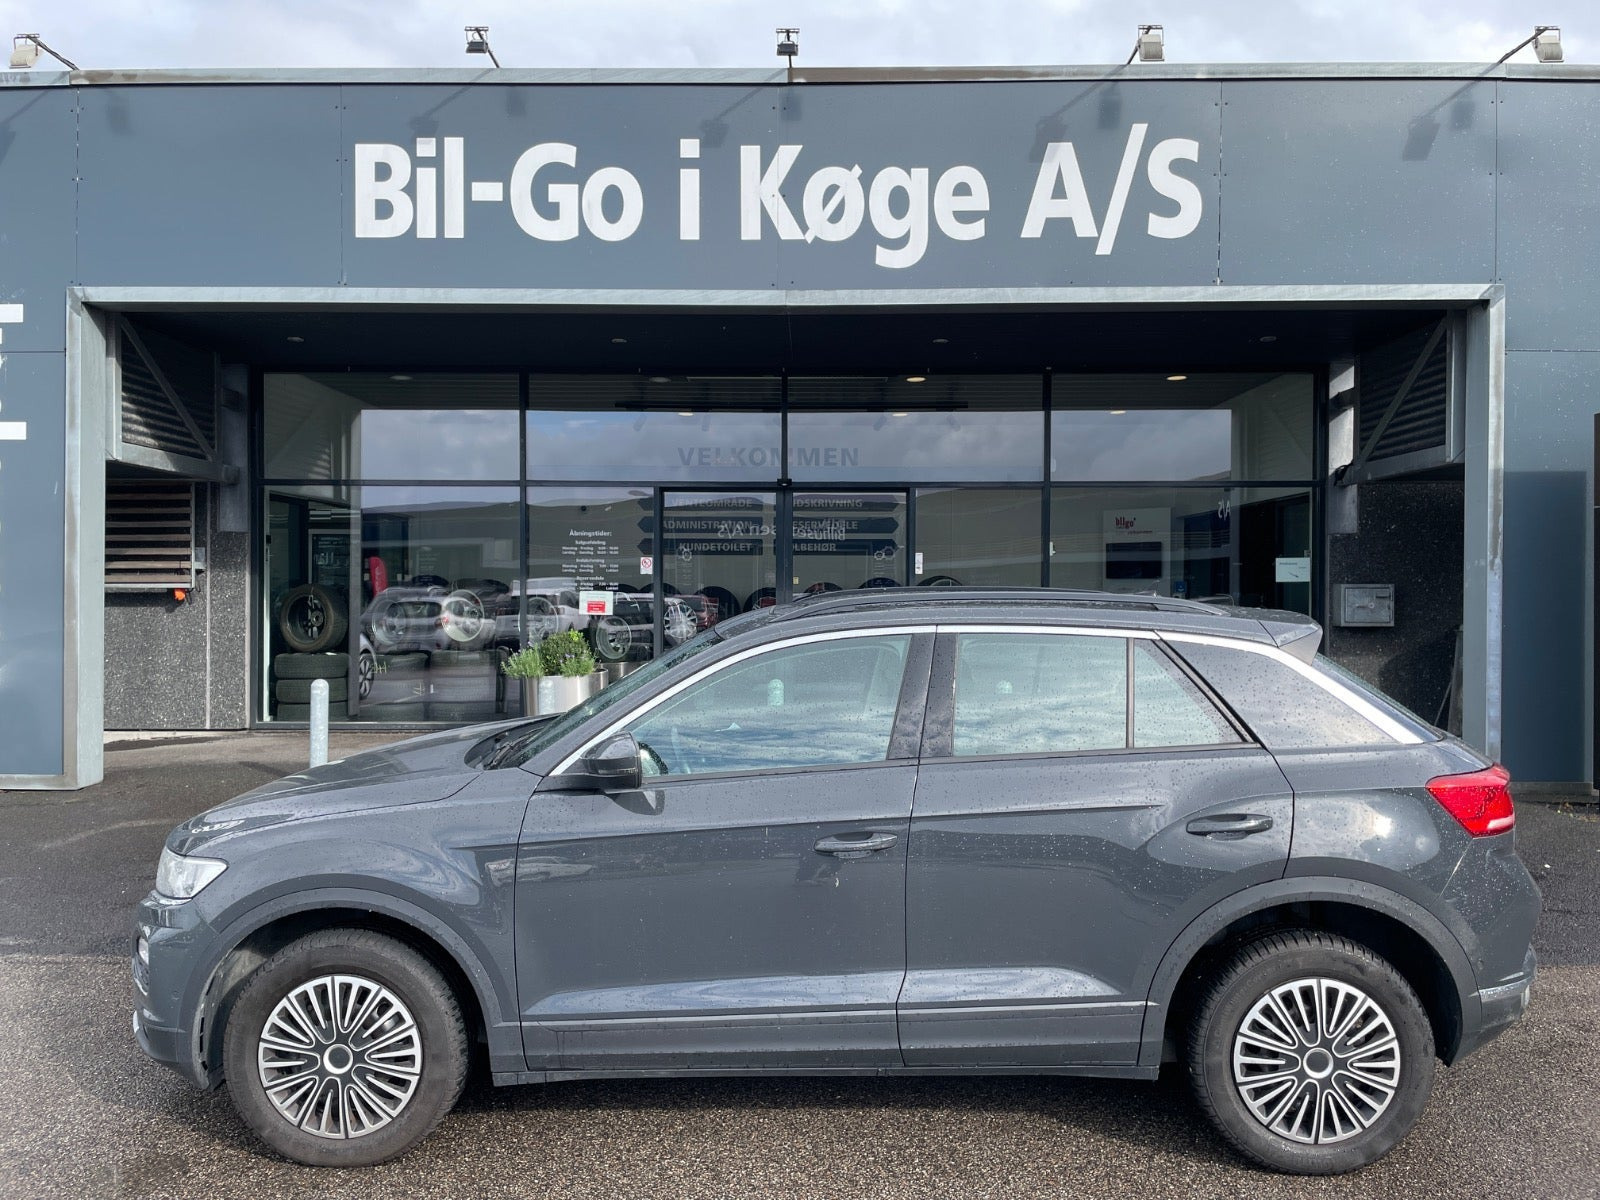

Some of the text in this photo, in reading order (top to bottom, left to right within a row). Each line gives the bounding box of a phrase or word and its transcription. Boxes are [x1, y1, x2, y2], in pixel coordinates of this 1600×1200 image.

[355, 123, 1202, 269] Bil-Go i Køge A/S
[678, 447, 859, 466] VELKOMMEN
[793, 499, 863, 508] DSKRIVNING
[793, 521, 859, 529] ESERVEDELE
[680, 542, 752, 552] KUNDETOILET
[793, 543, 837, 552] LBEHØR
